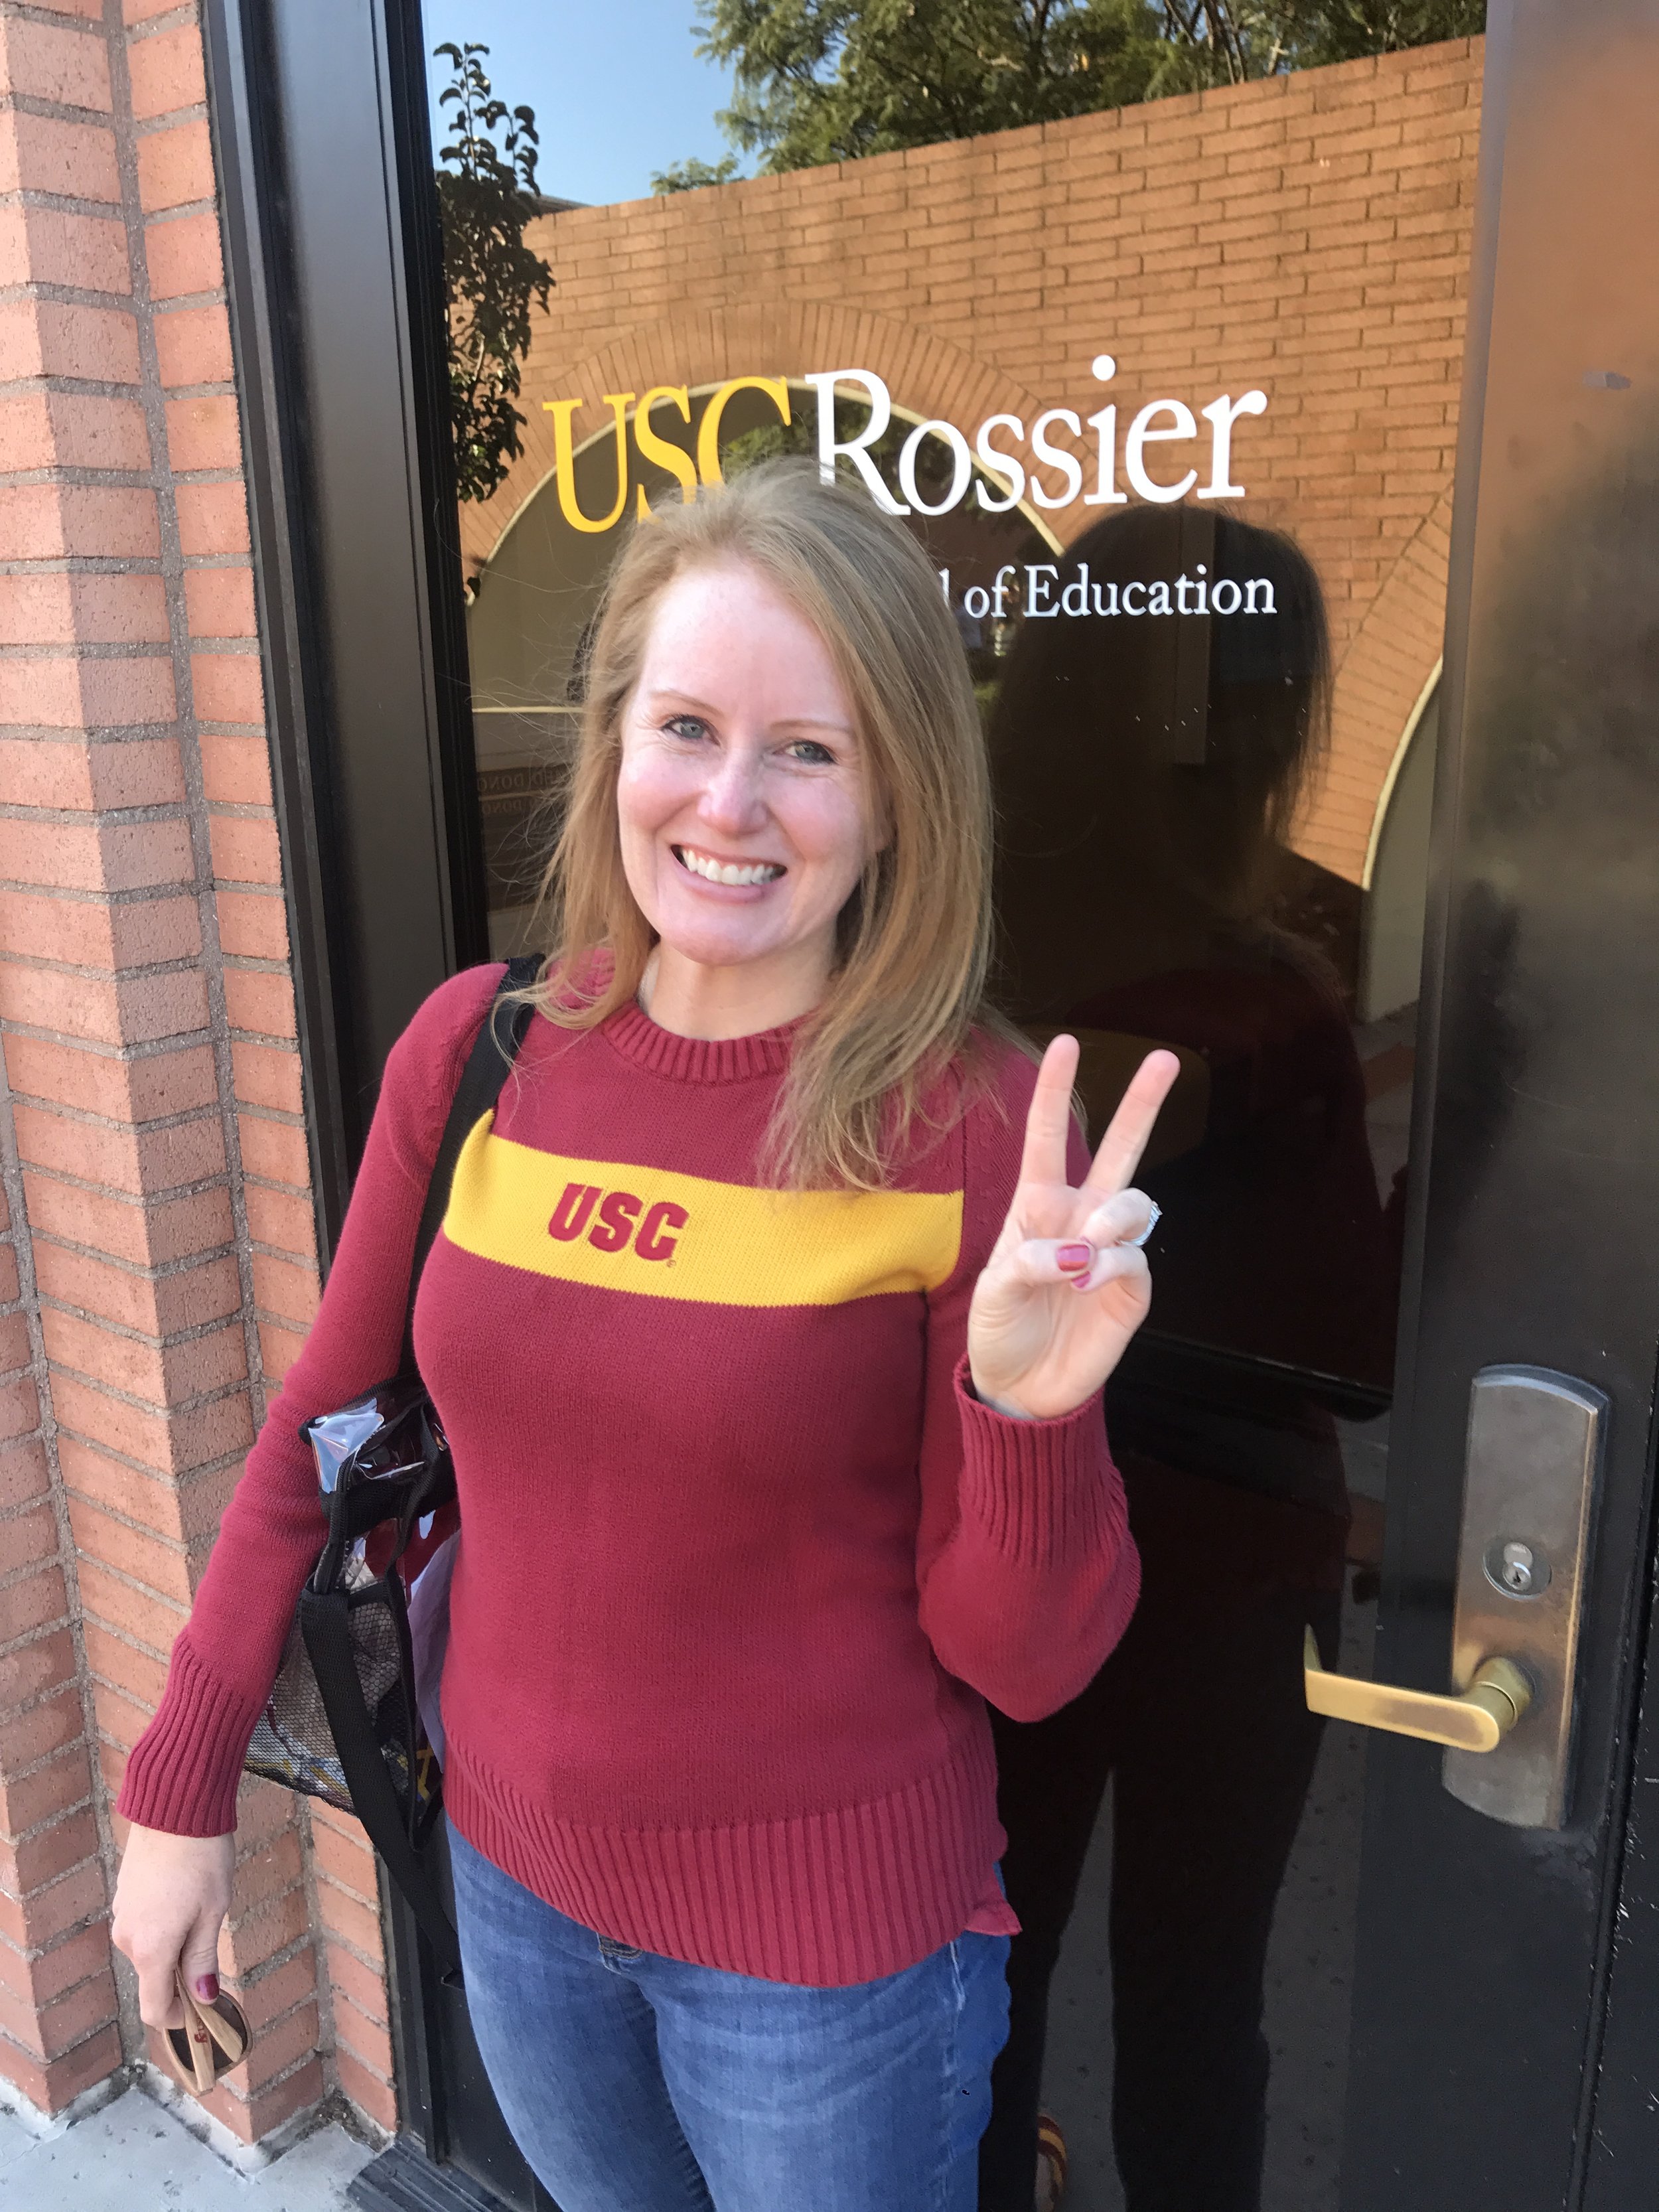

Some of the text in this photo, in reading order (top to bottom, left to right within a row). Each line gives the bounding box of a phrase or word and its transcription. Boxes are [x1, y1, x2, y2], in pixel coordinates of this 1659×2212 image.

[542, 354, 1267, 533] USC Rossier
[964, 565, 1016, 619] of
[1024, 563, 1277, 618] Education
[548, 1183, 689, 1261] USC
